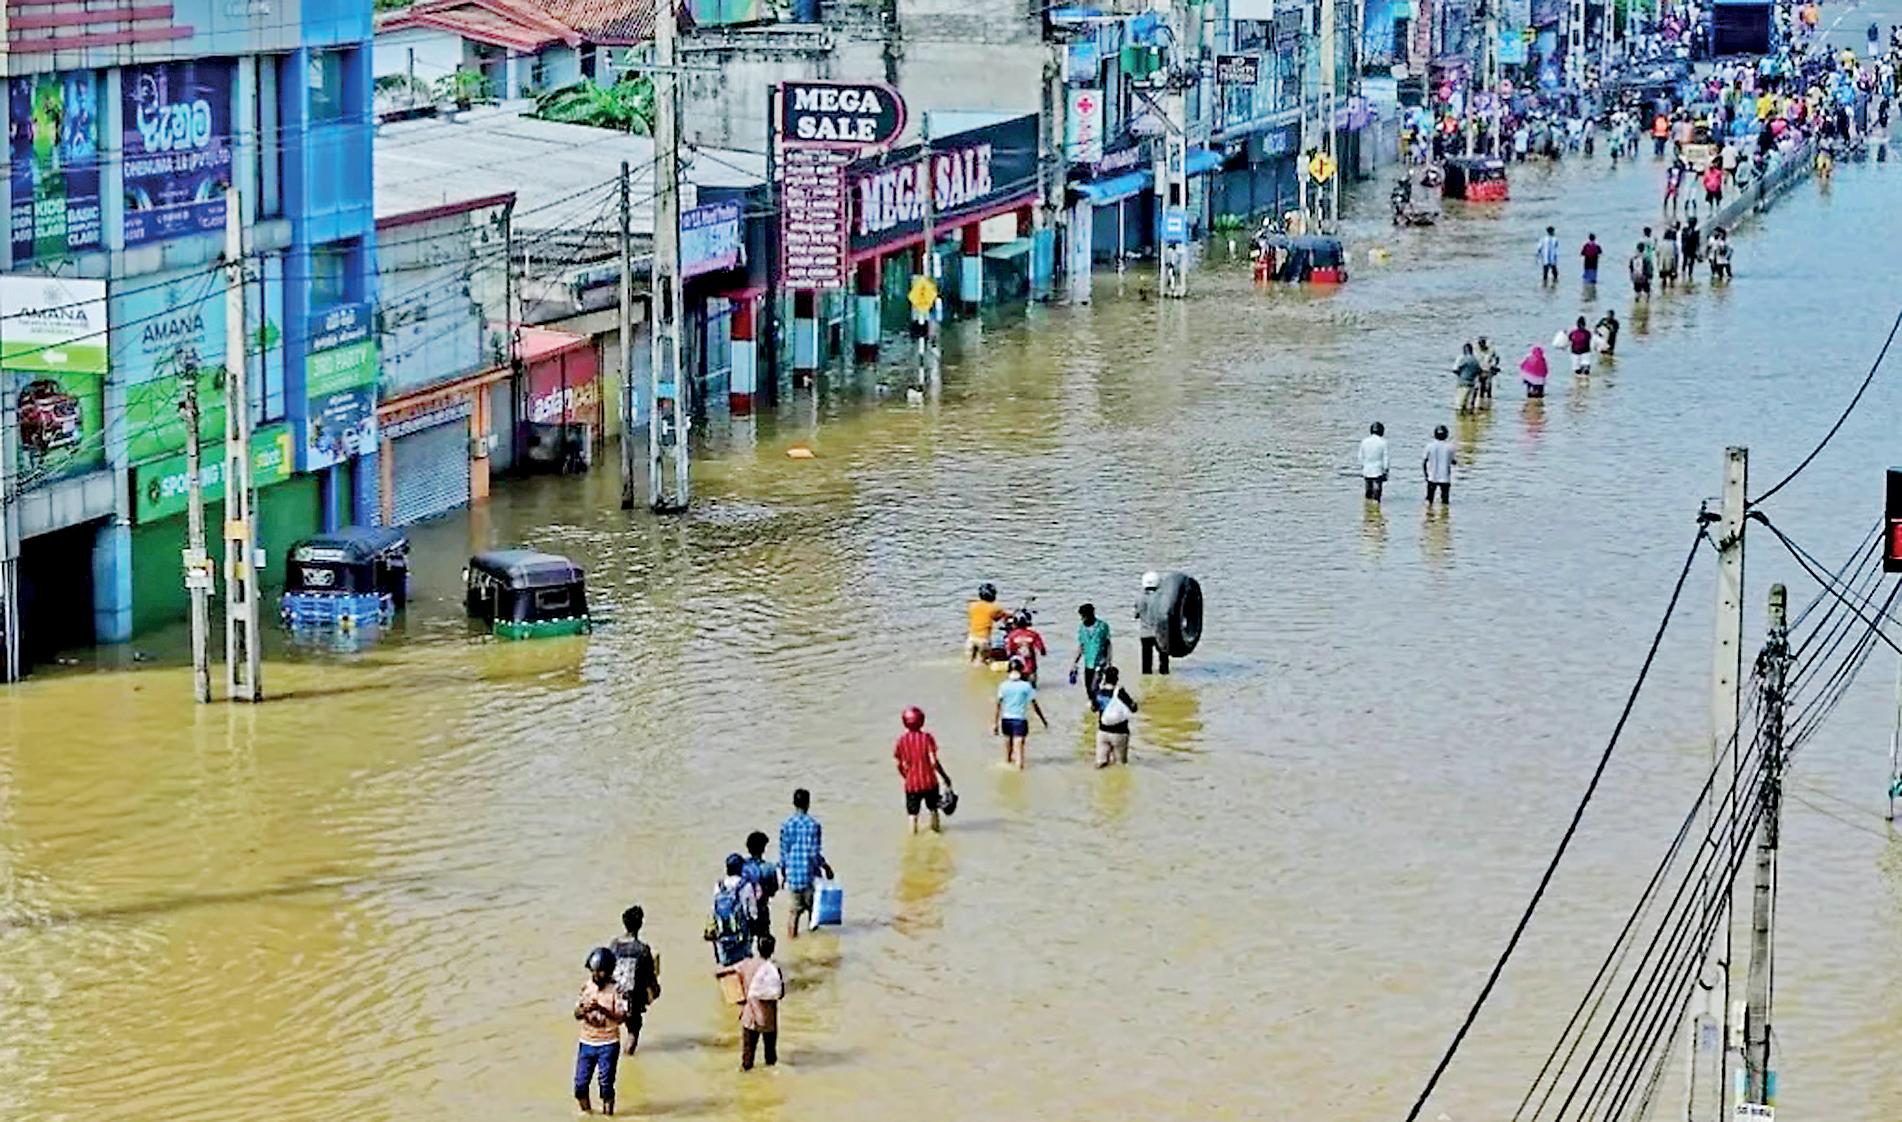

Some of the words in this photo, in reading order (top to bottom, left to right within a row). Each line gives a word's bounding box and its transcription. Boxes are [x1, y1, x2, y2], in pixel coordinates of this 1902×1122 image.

[794, 87, 882, 113] MEGA
[797, 115, 877, 140] SALE
[860, 163, 927, 236] MEGA
[936, 144, 991, 210] SALE
[20, 308, 88, 320] AMANA
[142, 314, 204, 344] AMANA
